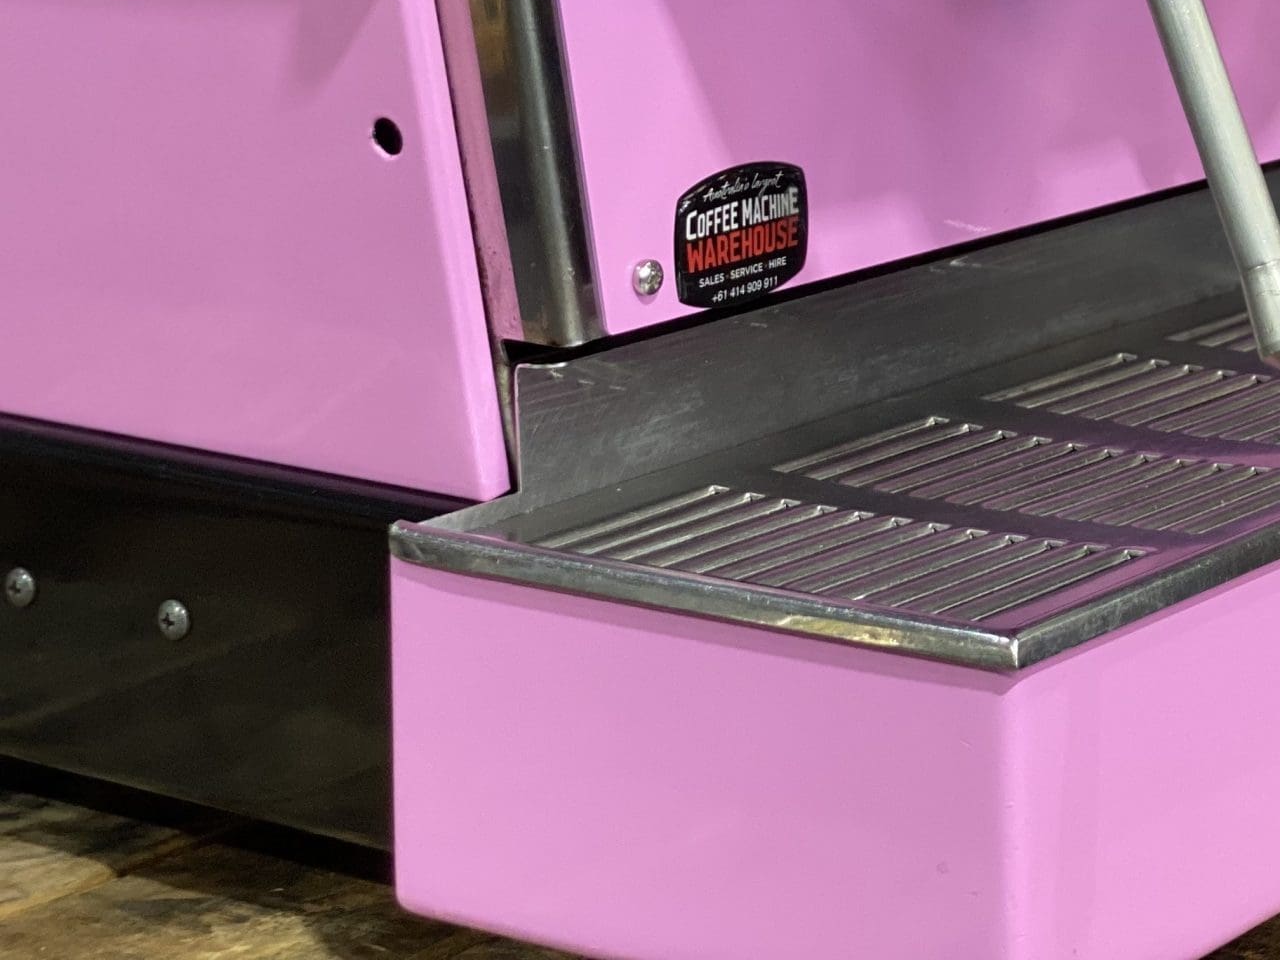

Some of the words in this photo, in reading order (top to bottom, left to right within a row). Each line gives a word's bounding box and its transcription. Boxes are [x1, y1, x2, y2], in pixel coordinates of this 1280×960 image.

[686, 201, 738, 240] COFFEE
[742, 187, 799, 227] MACHINE
[686, 216, 799, 274] WAREHOUSE
[699, 273, 725, 288] SALES
[730, 262, 763, 280] SERVICE
[769, 256, 787, 269] HIRE
[712, 289, 727, 303] +61
[729, 284, 745, 297] 414
[747, 279, 762, 293] 909
[764, 275, 778, 288] 911
